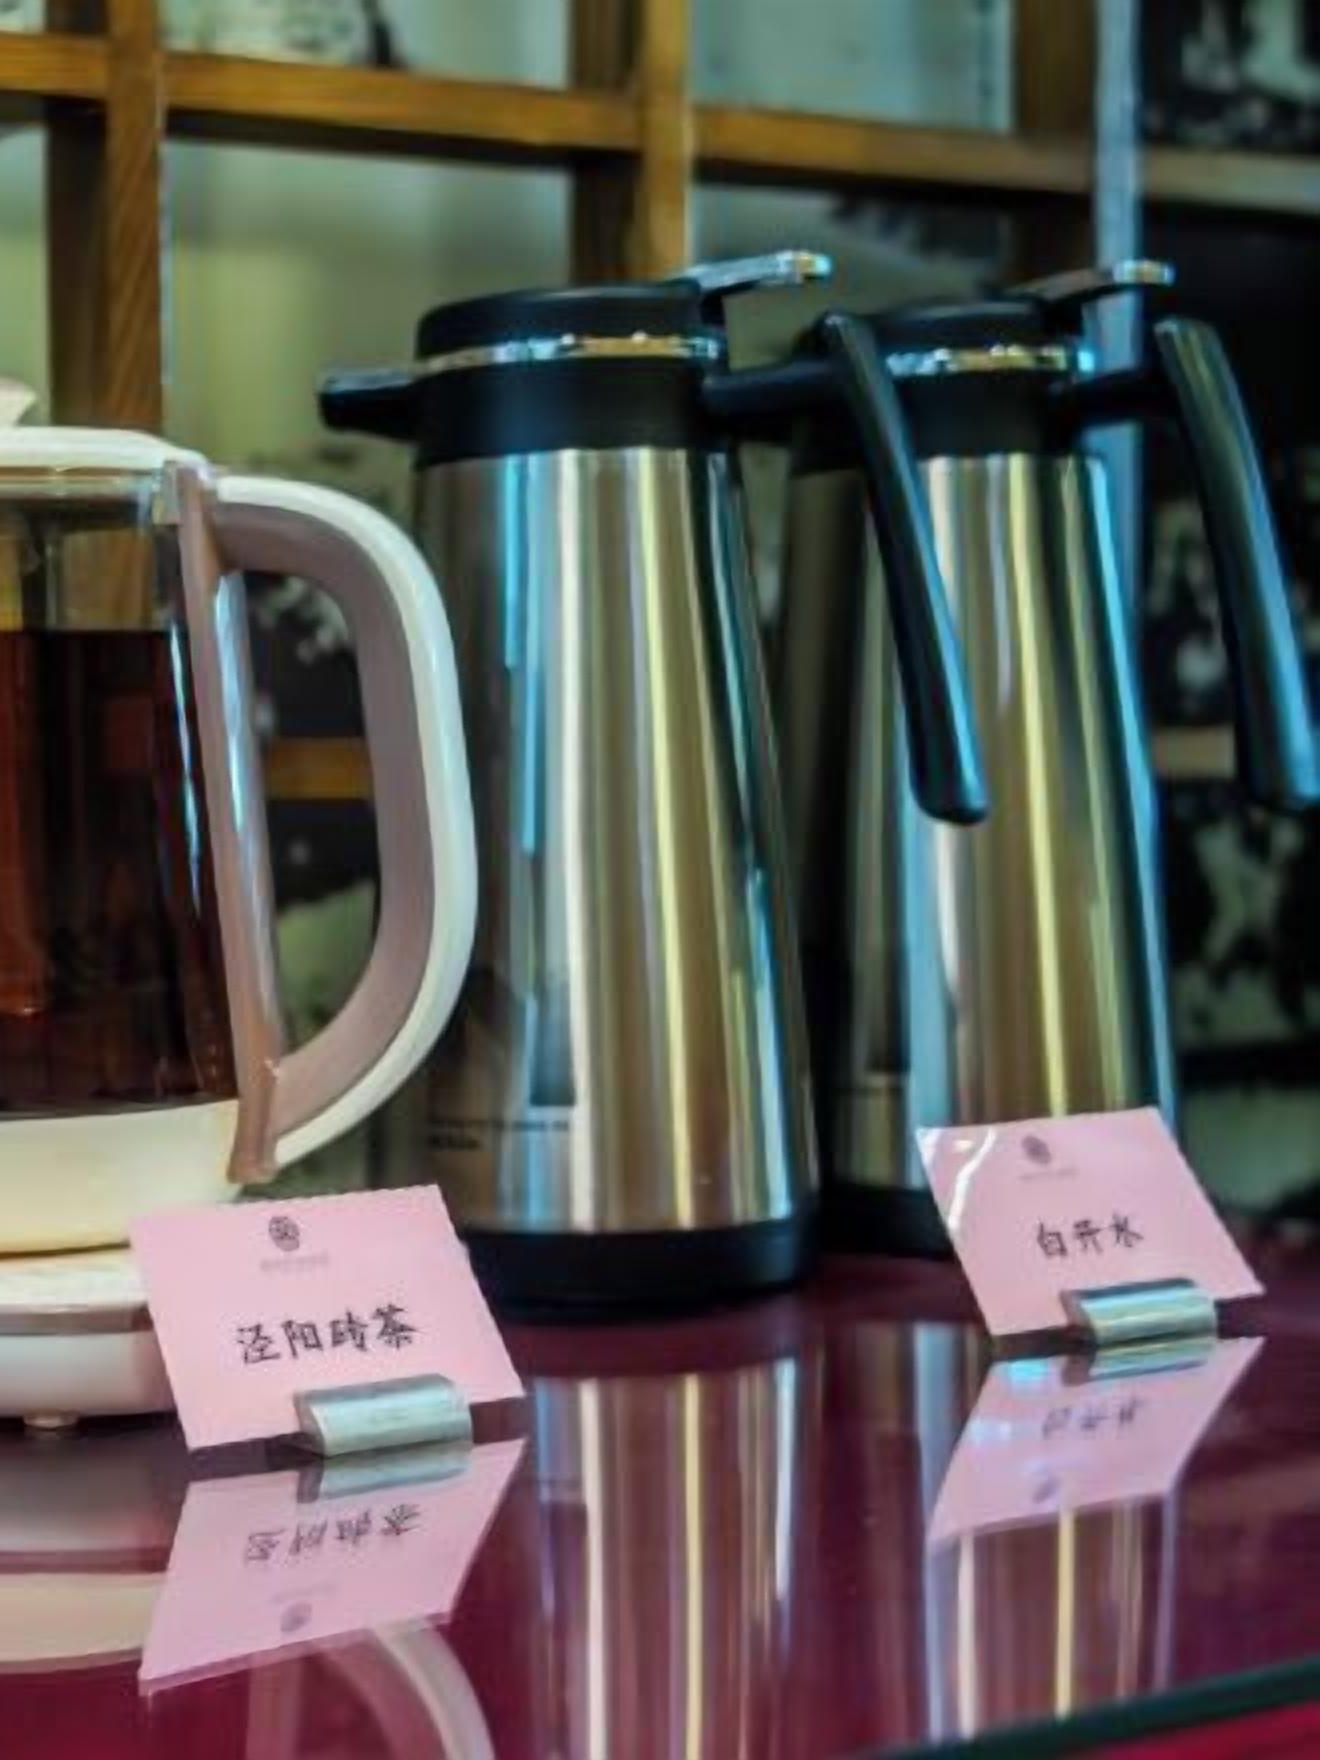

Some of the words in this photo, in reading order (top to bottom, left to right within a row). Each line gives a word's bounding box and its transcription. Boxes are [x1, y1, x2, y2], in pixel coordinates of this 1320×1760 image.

[1036, 1212, 1144, 1257] 白开水
[236, 1304, 418, 1365] 泾阳砖茶
